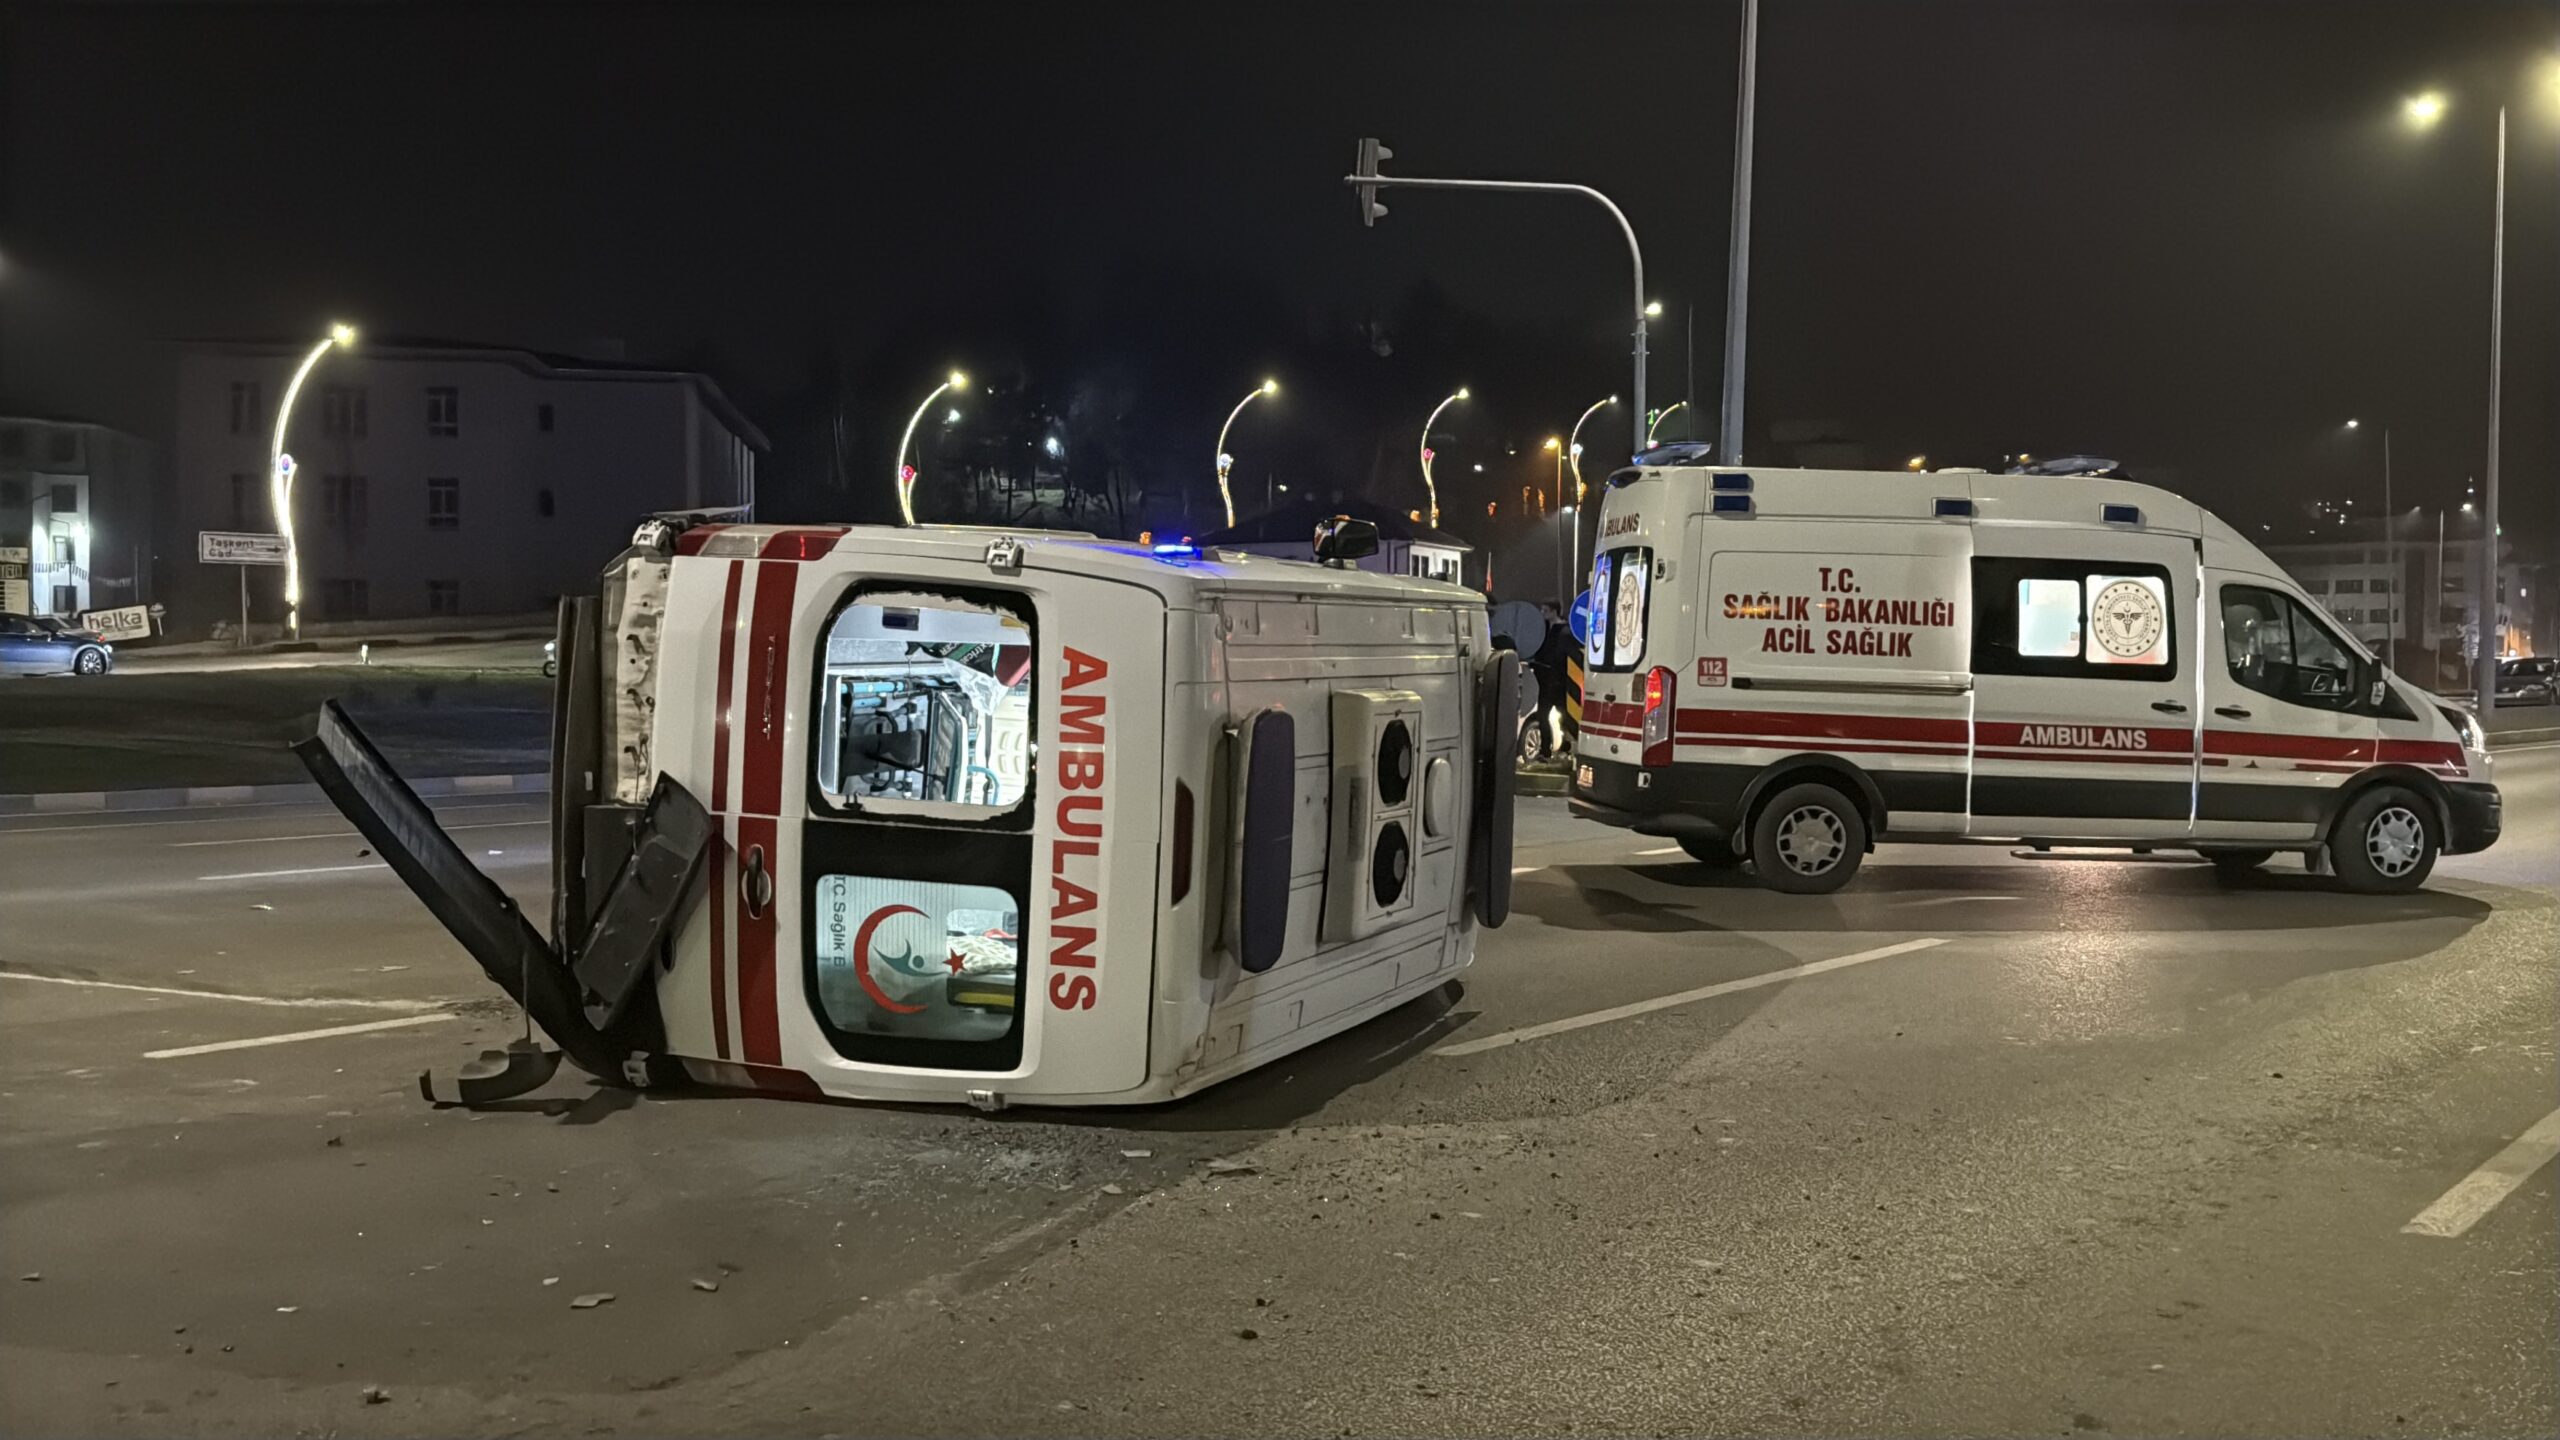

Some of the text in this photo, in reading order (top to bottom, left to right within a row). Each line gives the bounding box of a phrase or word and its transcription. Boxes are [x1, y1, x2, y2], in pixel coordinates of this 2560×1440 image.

[1818, 567, 1861, 593] T.C.
[88, 611, 142, 630] helka
[1723, 591, 1954, 627] SAĞLIK BAKANLIĞI
[1761, 624, 1913, 657] ACİL SAĞLIK
[1702, 660, 1723, 675] 112
[2020, 725, 2147, 749] AMBULANS
[1049, 645, 1108, 1011] AMBULANS
[830, 902, 846, 951] Sağlık
